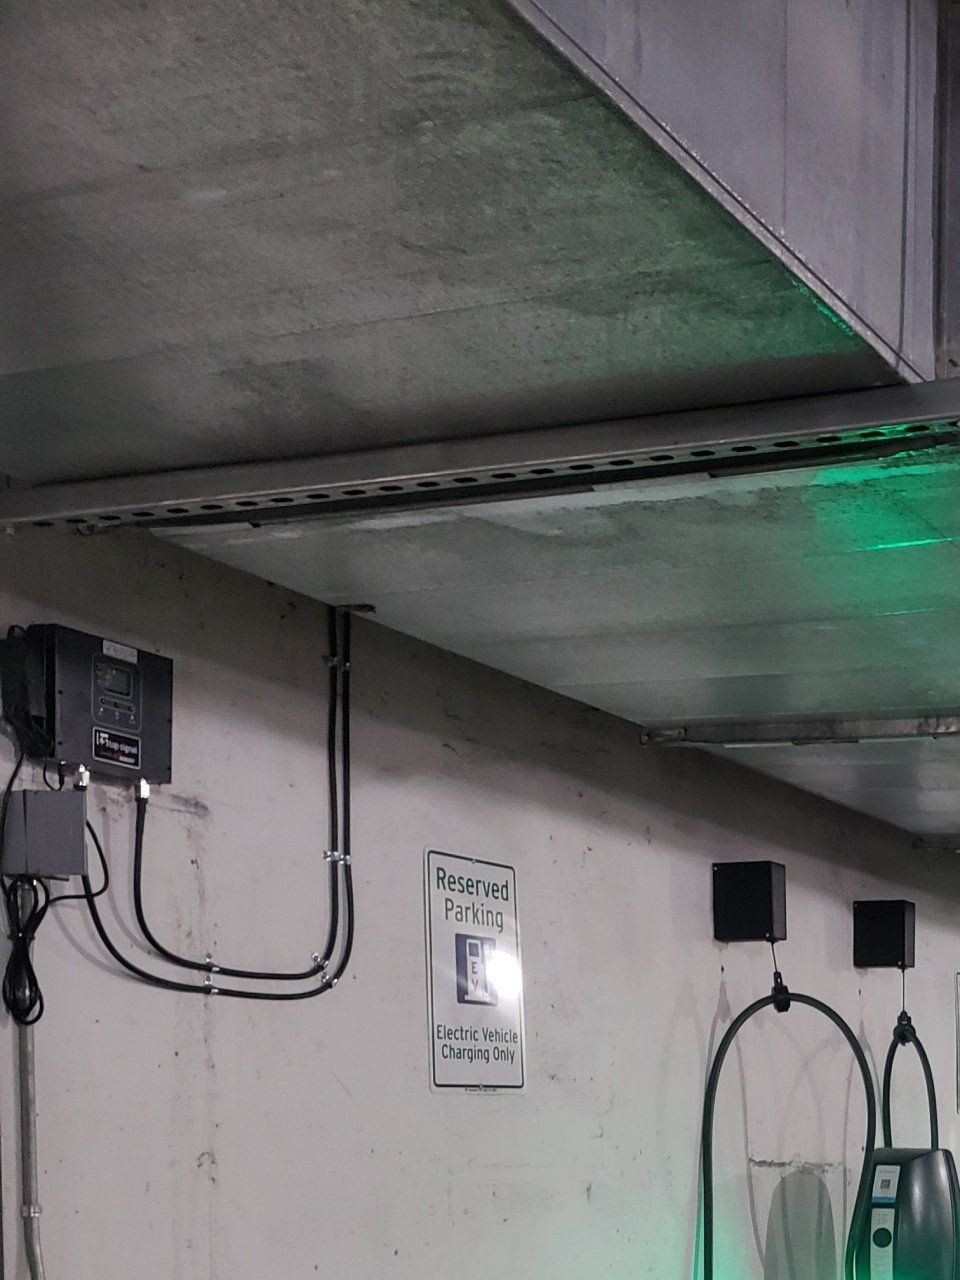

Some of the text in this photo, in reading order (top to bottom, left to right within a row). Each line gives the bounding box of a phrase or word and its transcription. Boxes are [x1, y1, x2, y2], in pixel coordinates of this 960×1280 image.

[436, 866, 509, 902] Reserved
[444, 897, 504, 933] Parking
[436, 1024, 518, 1044] Electric Vehicle
[441, 1043, 515, 1065] Charging Only
